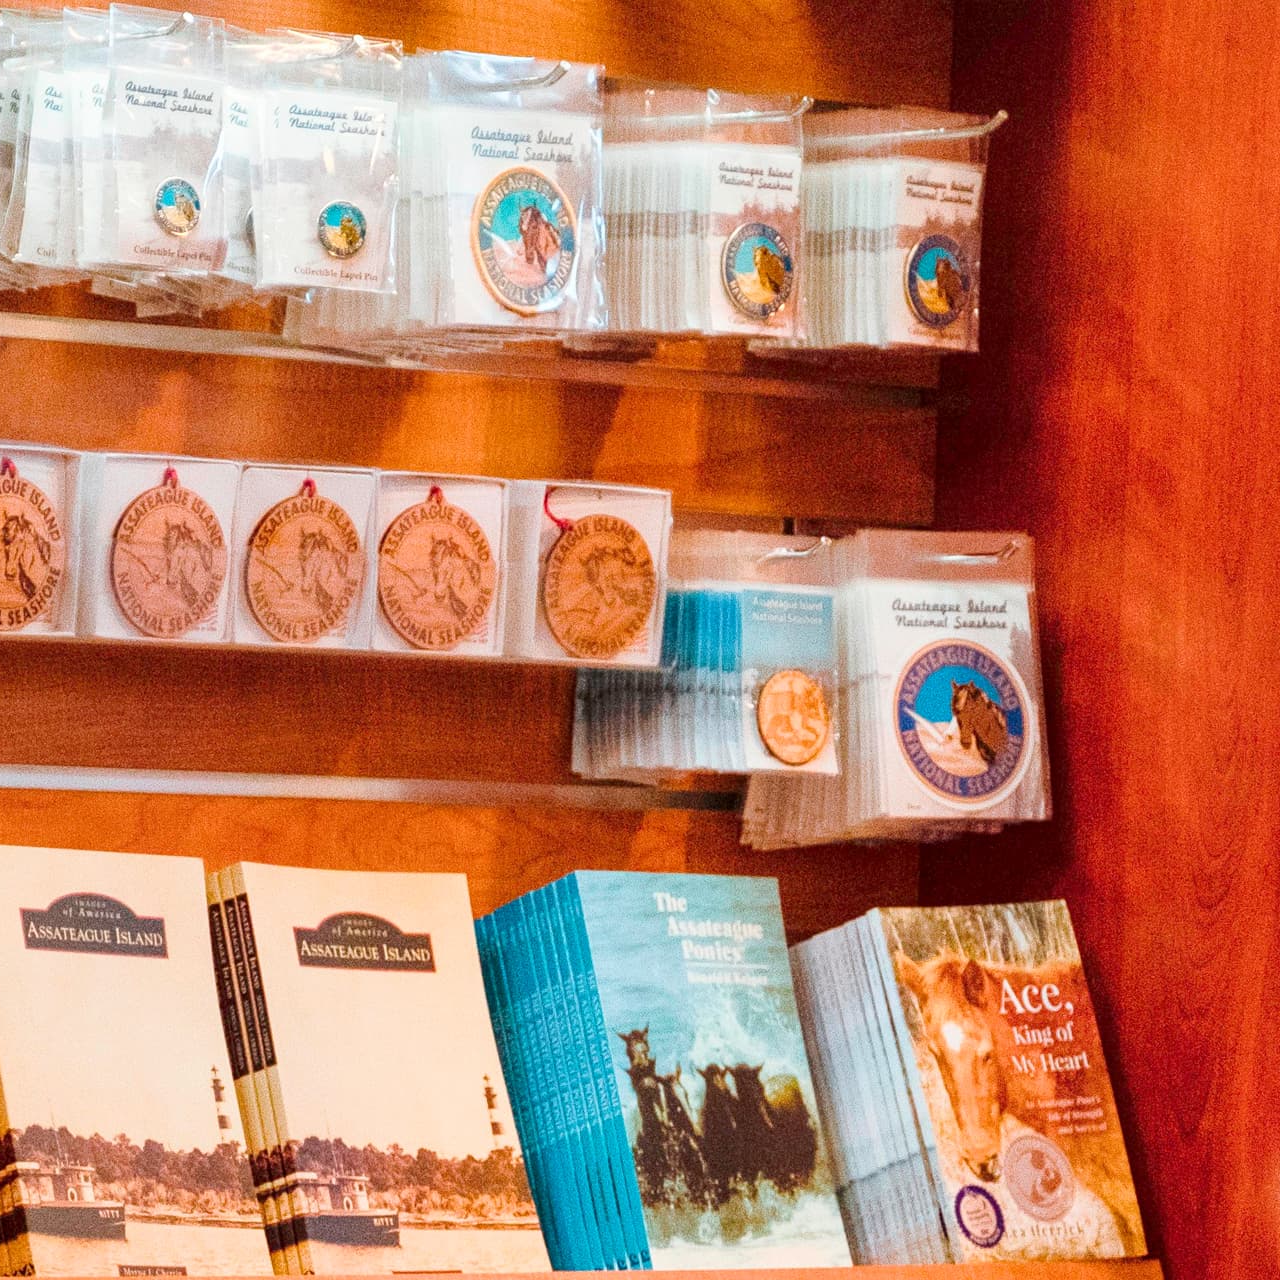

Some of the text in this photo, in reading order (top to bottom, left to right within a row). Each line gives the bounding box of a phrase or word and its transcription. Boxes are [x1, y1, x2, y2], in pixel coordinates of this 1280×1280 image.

[124, 80, 214, 103] Assateague Island
[471, 126, 573, 146] Assateague Island
[472, 143, 573, 163] National Seashore
[294, 265, 377, 281] Collectible Lapel Pin
[29, 483, 62, 542] ISLAND
[383, 505, 489, 563] ASSATEAGUE ISLAND
[8, 566, 62, 625] SEASHORE
[384, 585, 491, 645] NATIONAL SEASHORE
[891, 599, 1008, 616] Assateague Island
[896, 615, 1008, 630] National Seashore
[901, 650, 1018, 709] ASSATEAGUE ISLAND
[902, 731, 1022, 795] NATIONAL SEASHORE
[653, 893, 687, 913] The
[28, 921, 163, 947] ASSATEAGUE ISLAND
[667, 916, 764, 939] Assateague
[301, 940, 430, 962] ASSATEAGUE ISLAND
[682, 940, 744, 961] Ponies
[999, 979, 1074, 1016] Ace,
[1012, 1022, 1073, 1046] King of
[1011, 1052, 1089, 1072] My Heart
